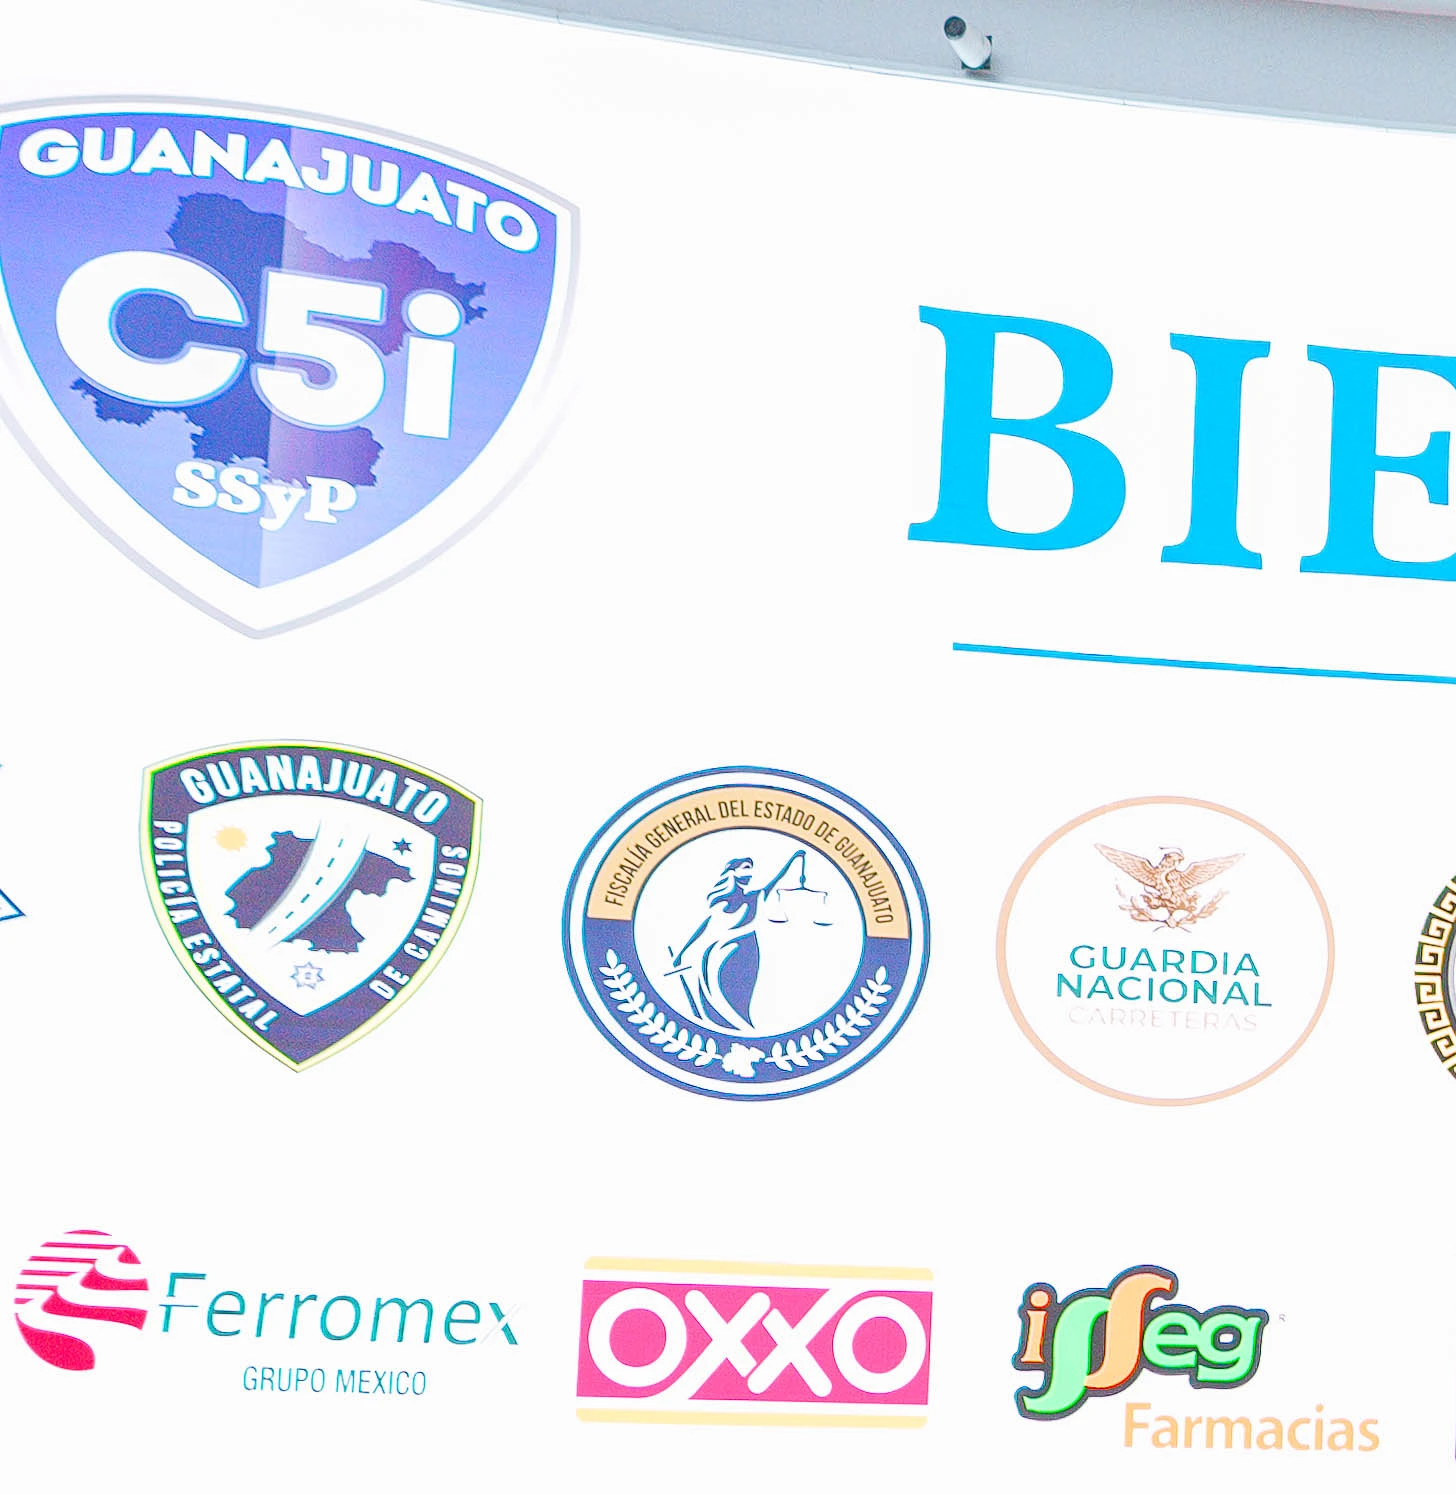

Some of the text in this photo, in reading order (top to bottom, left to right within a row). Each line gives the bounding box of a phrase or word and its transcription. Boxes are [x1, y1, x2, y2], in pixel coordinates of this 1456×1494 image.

[19, 126, 540, 253] GUANAJUATO
[55, 250, 462, 439] C5i
[172, 460, 358, 531] SSyP
[179, 754, 449, 826] GUANAJUATO
[605, 799, 895, 925] FISCALÍA GENERAL DEL ESTADO DE GUANAJUATO
[153, 820, 281, 1032] POLICÍA ESTATAL
[369, 845, 469, 1001] DE CAMINOS
[1056, 973, 1272, 1007] NACIONAL
[1069, 944, 1260, 977] GUARDIA
[159, 1272, 518, 1346] Ferromex
[587, 1287, 927, 1399] OXXO
[243, 1366, 427, 1396] GRUPO MEXICO
[1123, 1402, 1380, 1452] Farmacias
